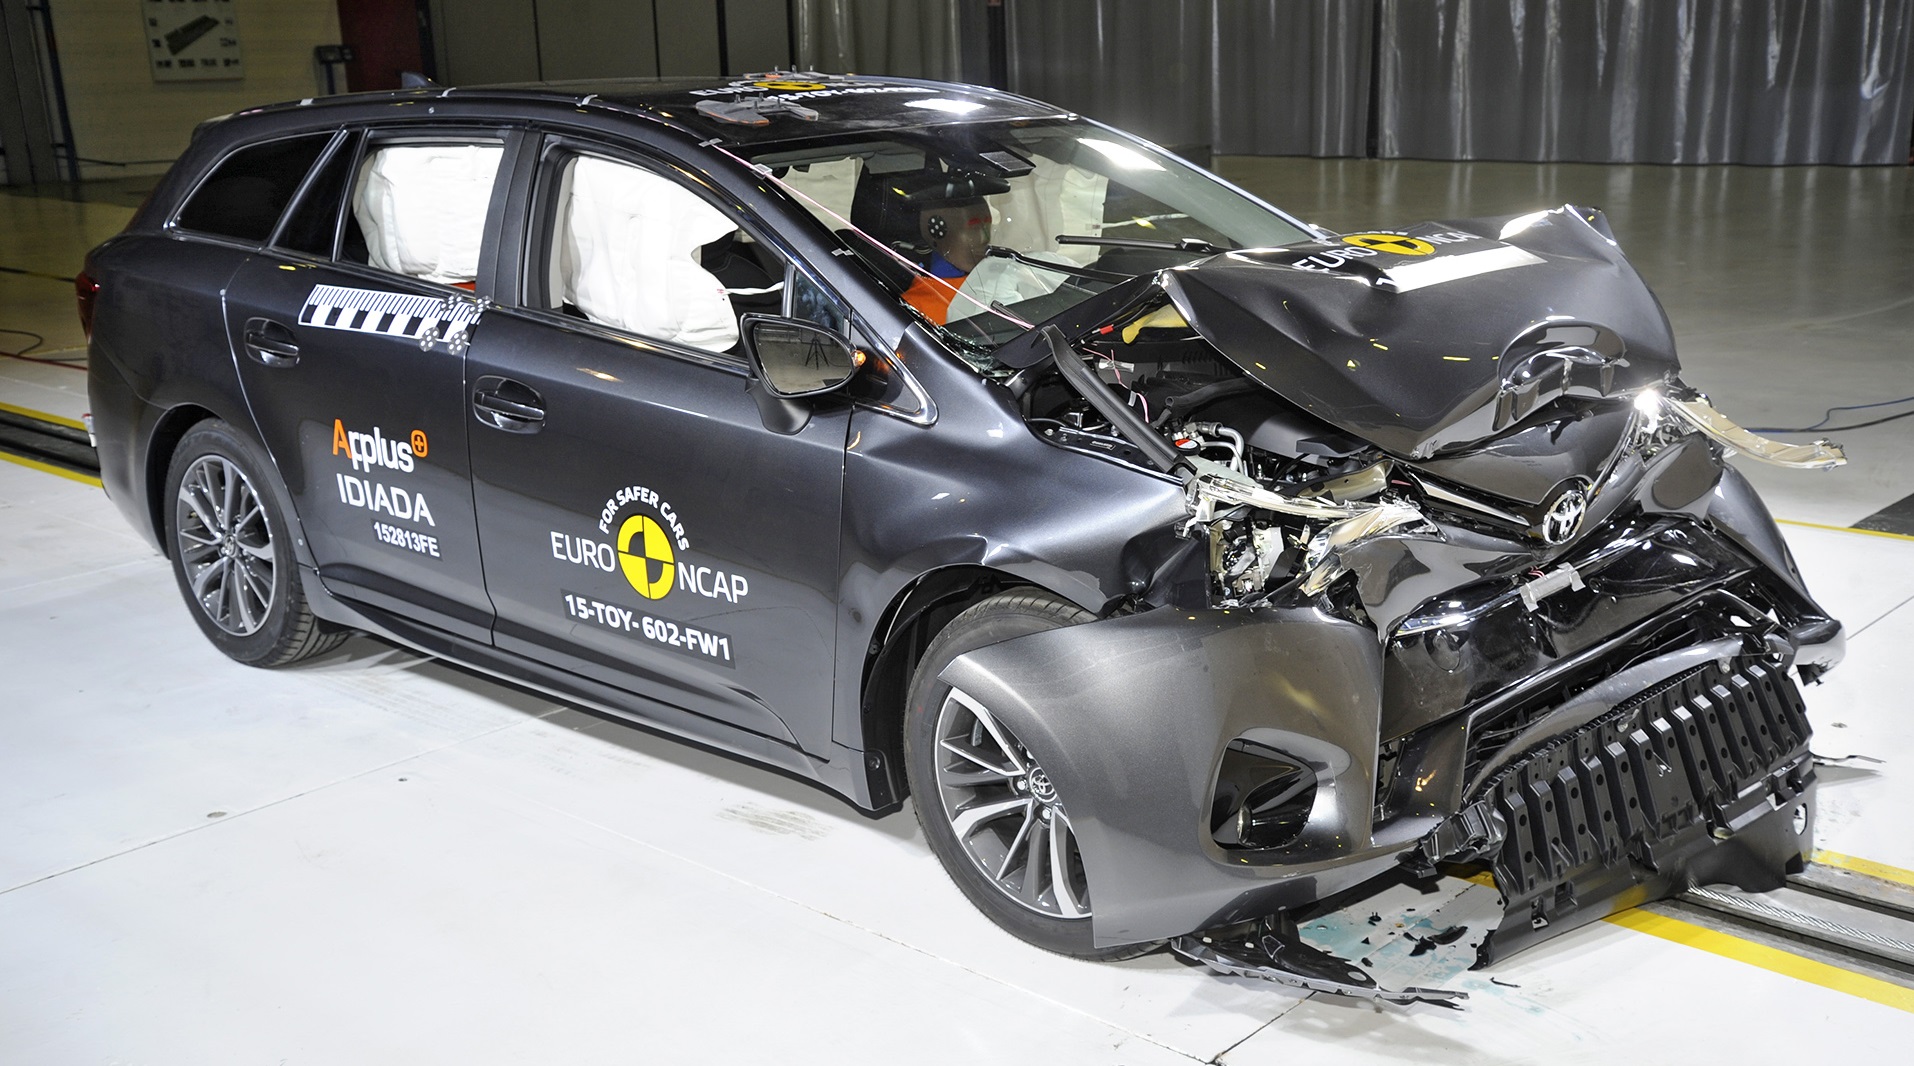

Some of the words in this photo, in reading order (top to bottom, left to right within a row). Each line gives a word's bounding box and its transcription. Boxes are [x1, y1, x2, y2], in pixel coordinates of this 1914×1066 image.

[336, 473, 436, 527] IDIADA
[598, 498, 619, 535] FOR
[615, 485, 660, 509] SAFER
[659, 501, 690, 551] CARS
[373, 521, 440, 558] 152813FE
[550, 531, 616, 573] EURO
[677, 561, 749, 604] NCAP
